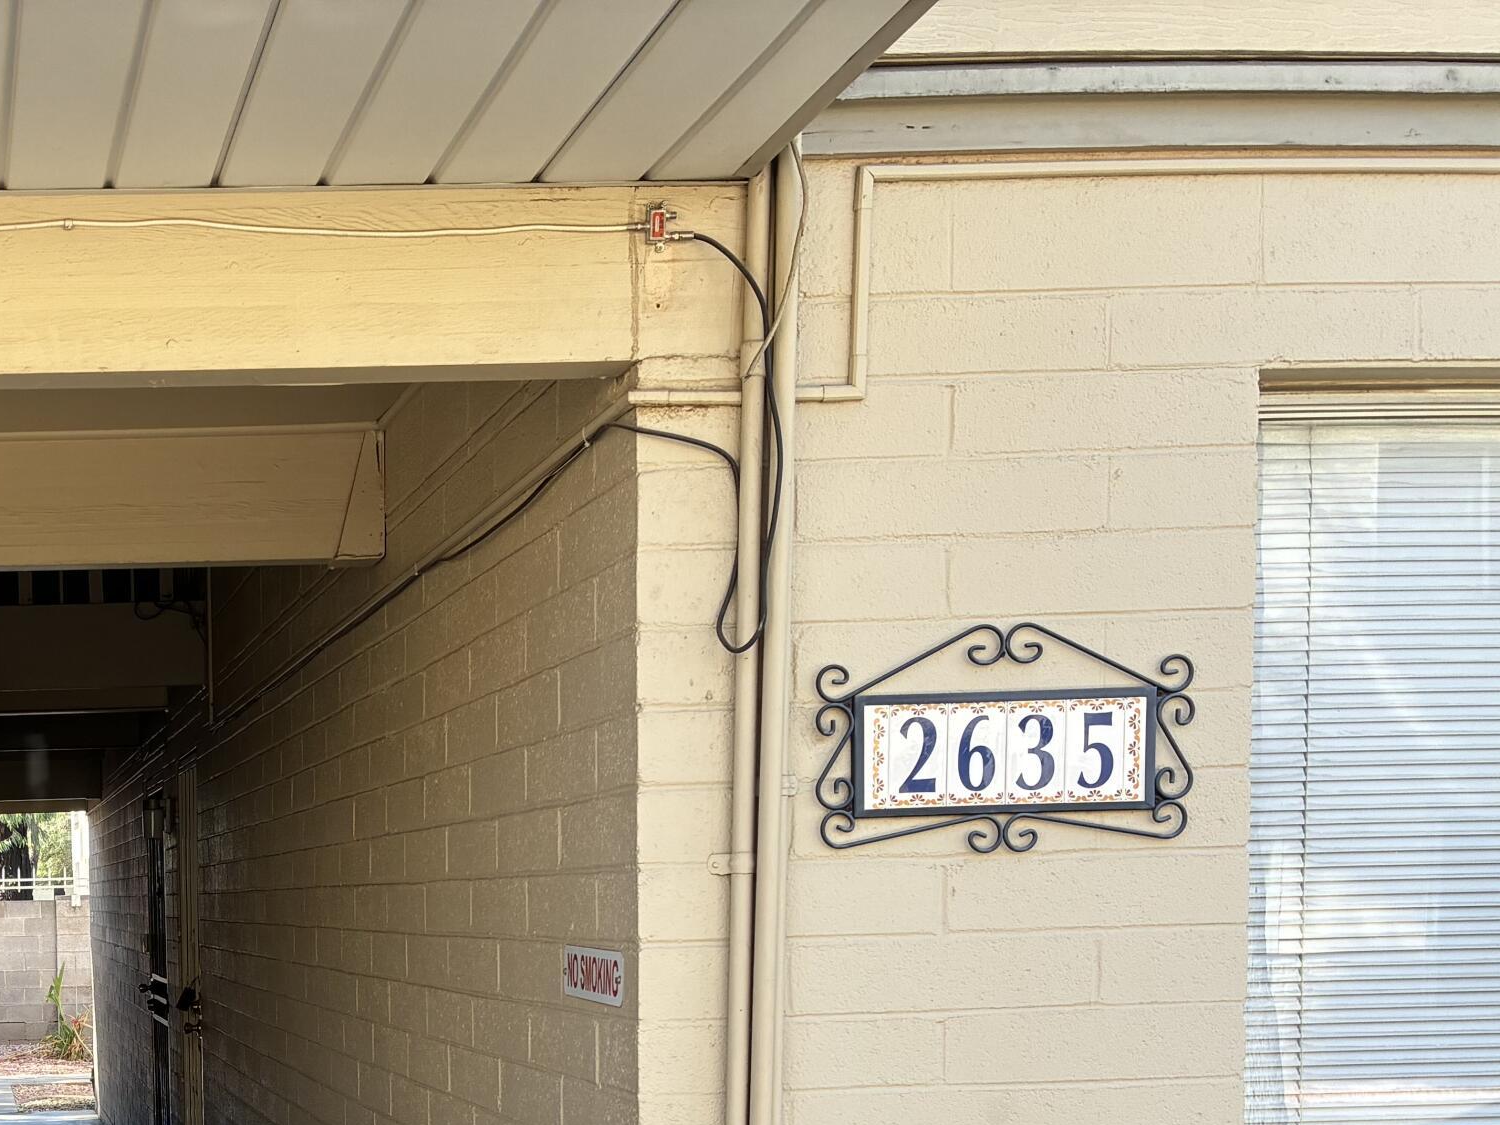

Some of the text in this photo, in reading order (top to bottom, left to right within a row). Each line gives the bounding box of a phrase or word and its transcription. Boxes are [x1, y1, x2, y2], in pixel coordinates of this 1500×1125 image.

[898, 710, 1115, 794] 2635
[567, 952, 619, 998] NO SMOKING
